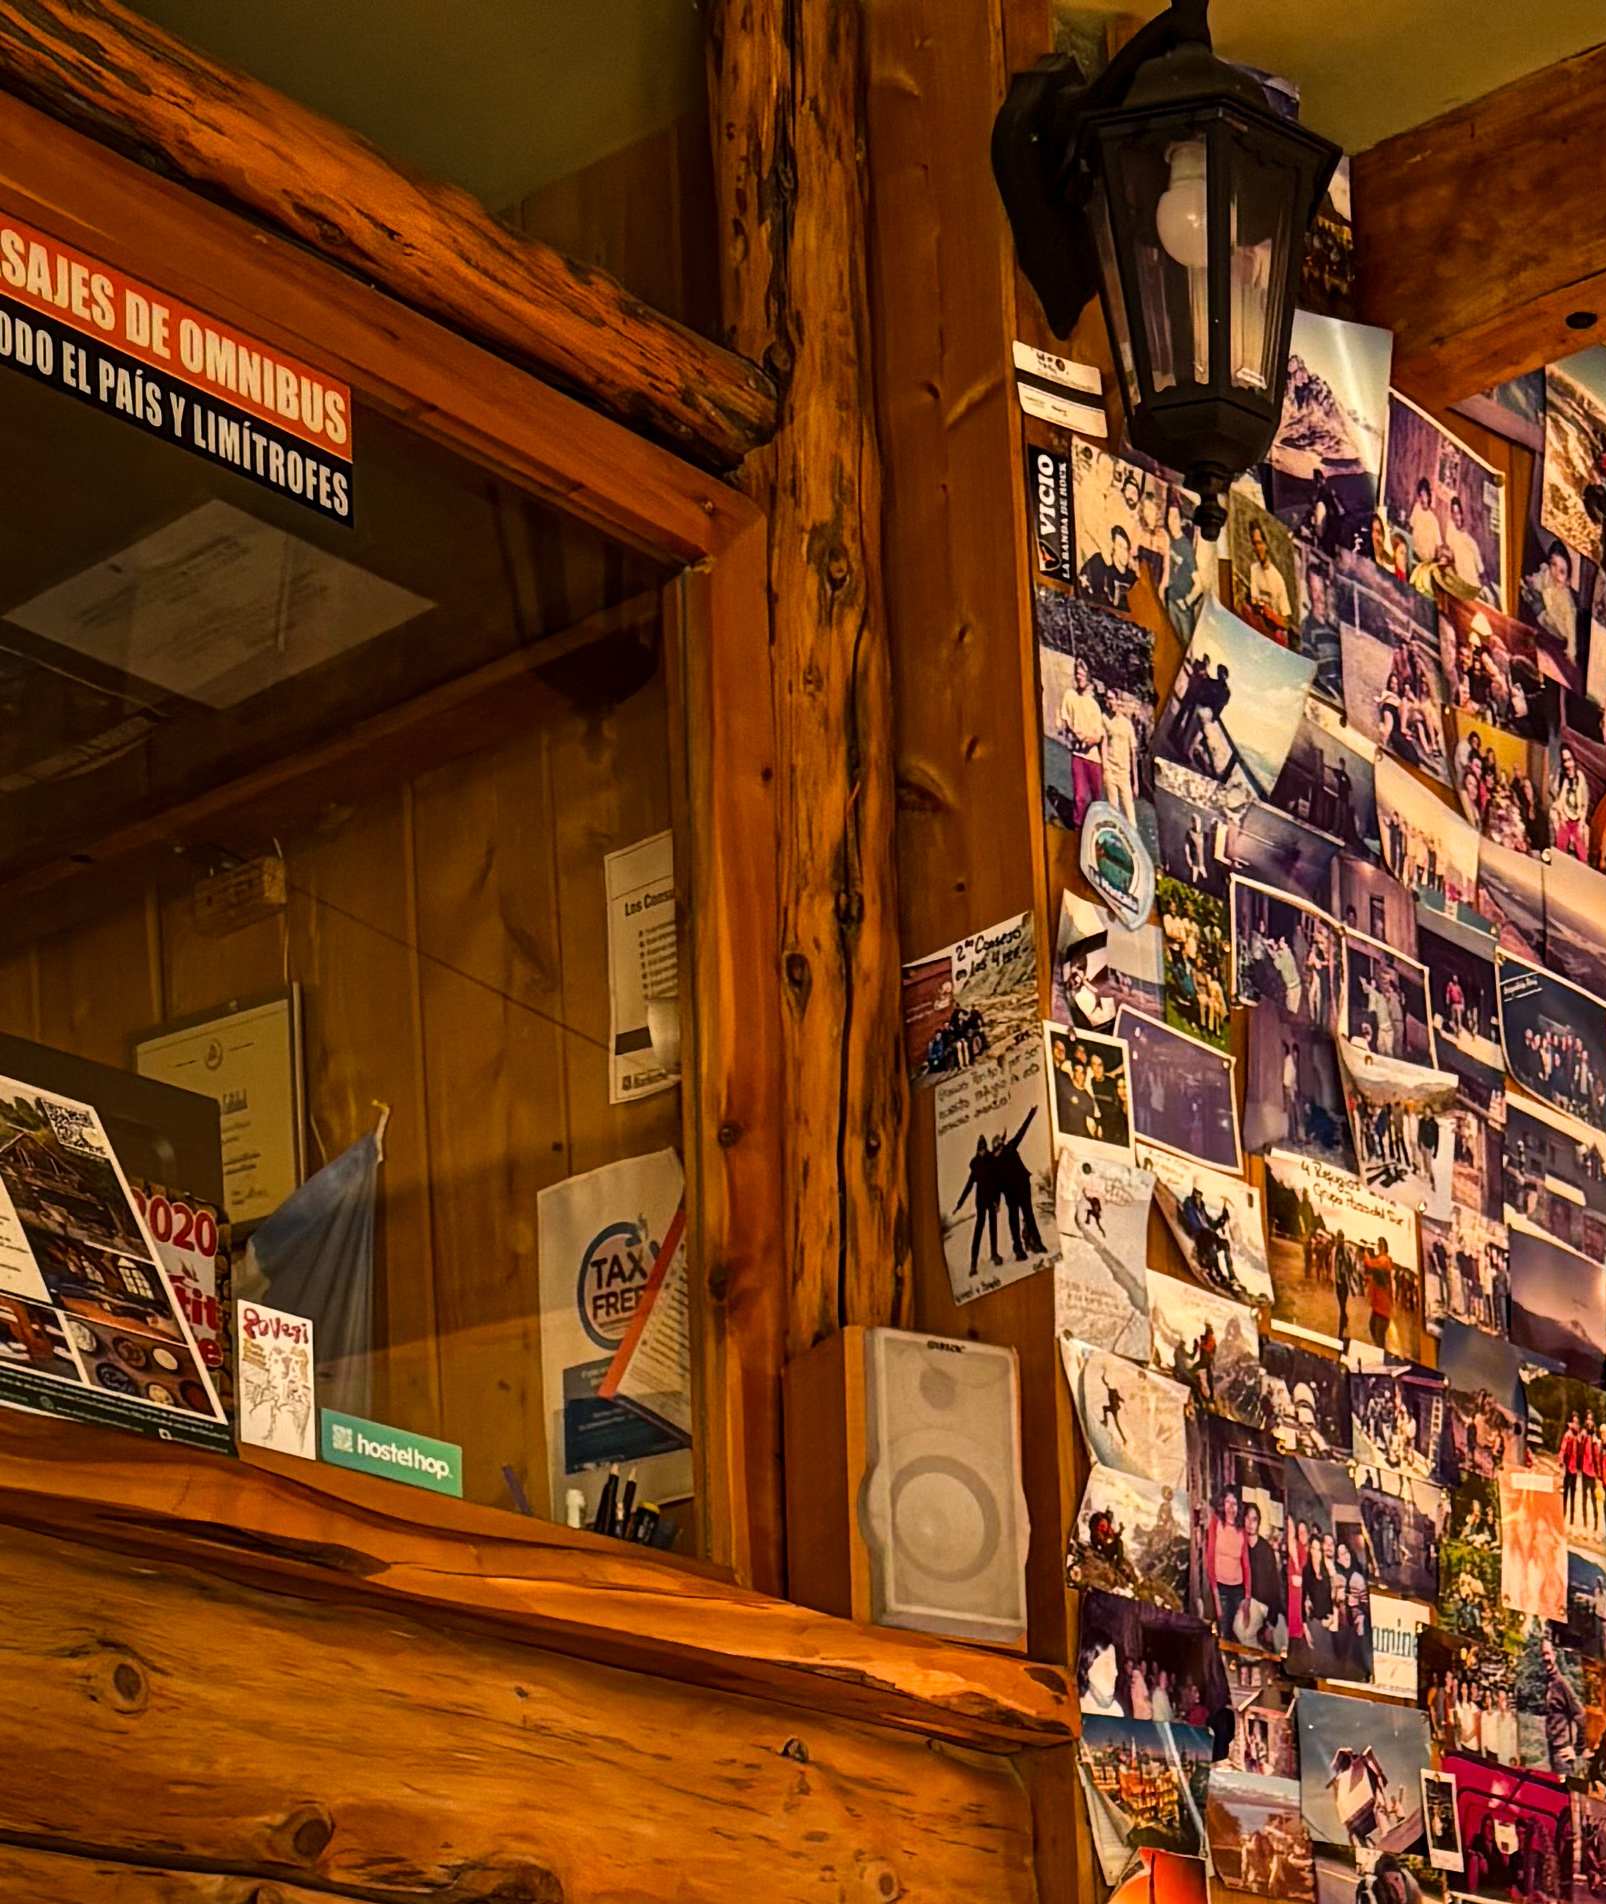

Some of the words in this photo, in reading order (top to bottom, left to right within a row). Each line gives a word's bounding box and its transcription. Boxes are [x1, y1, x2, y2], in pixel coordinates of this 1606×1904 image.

[0, 229, 115, 331] SAJES
[125, 289, 171, 360] DE
[179, 318, 348, 445] OMNIBUS
[0, 310, 53, 376] ODO
[62, 340, 92, 395] EL
[99, 357, 163, 428] PAÍS
[170, 392, 186, 438] Y
[193, 403, 349, 517] LIMÍTROFES
[1037, 454, 1056, 536] VICIO
[590, 1251, 648, 1290] TAX
